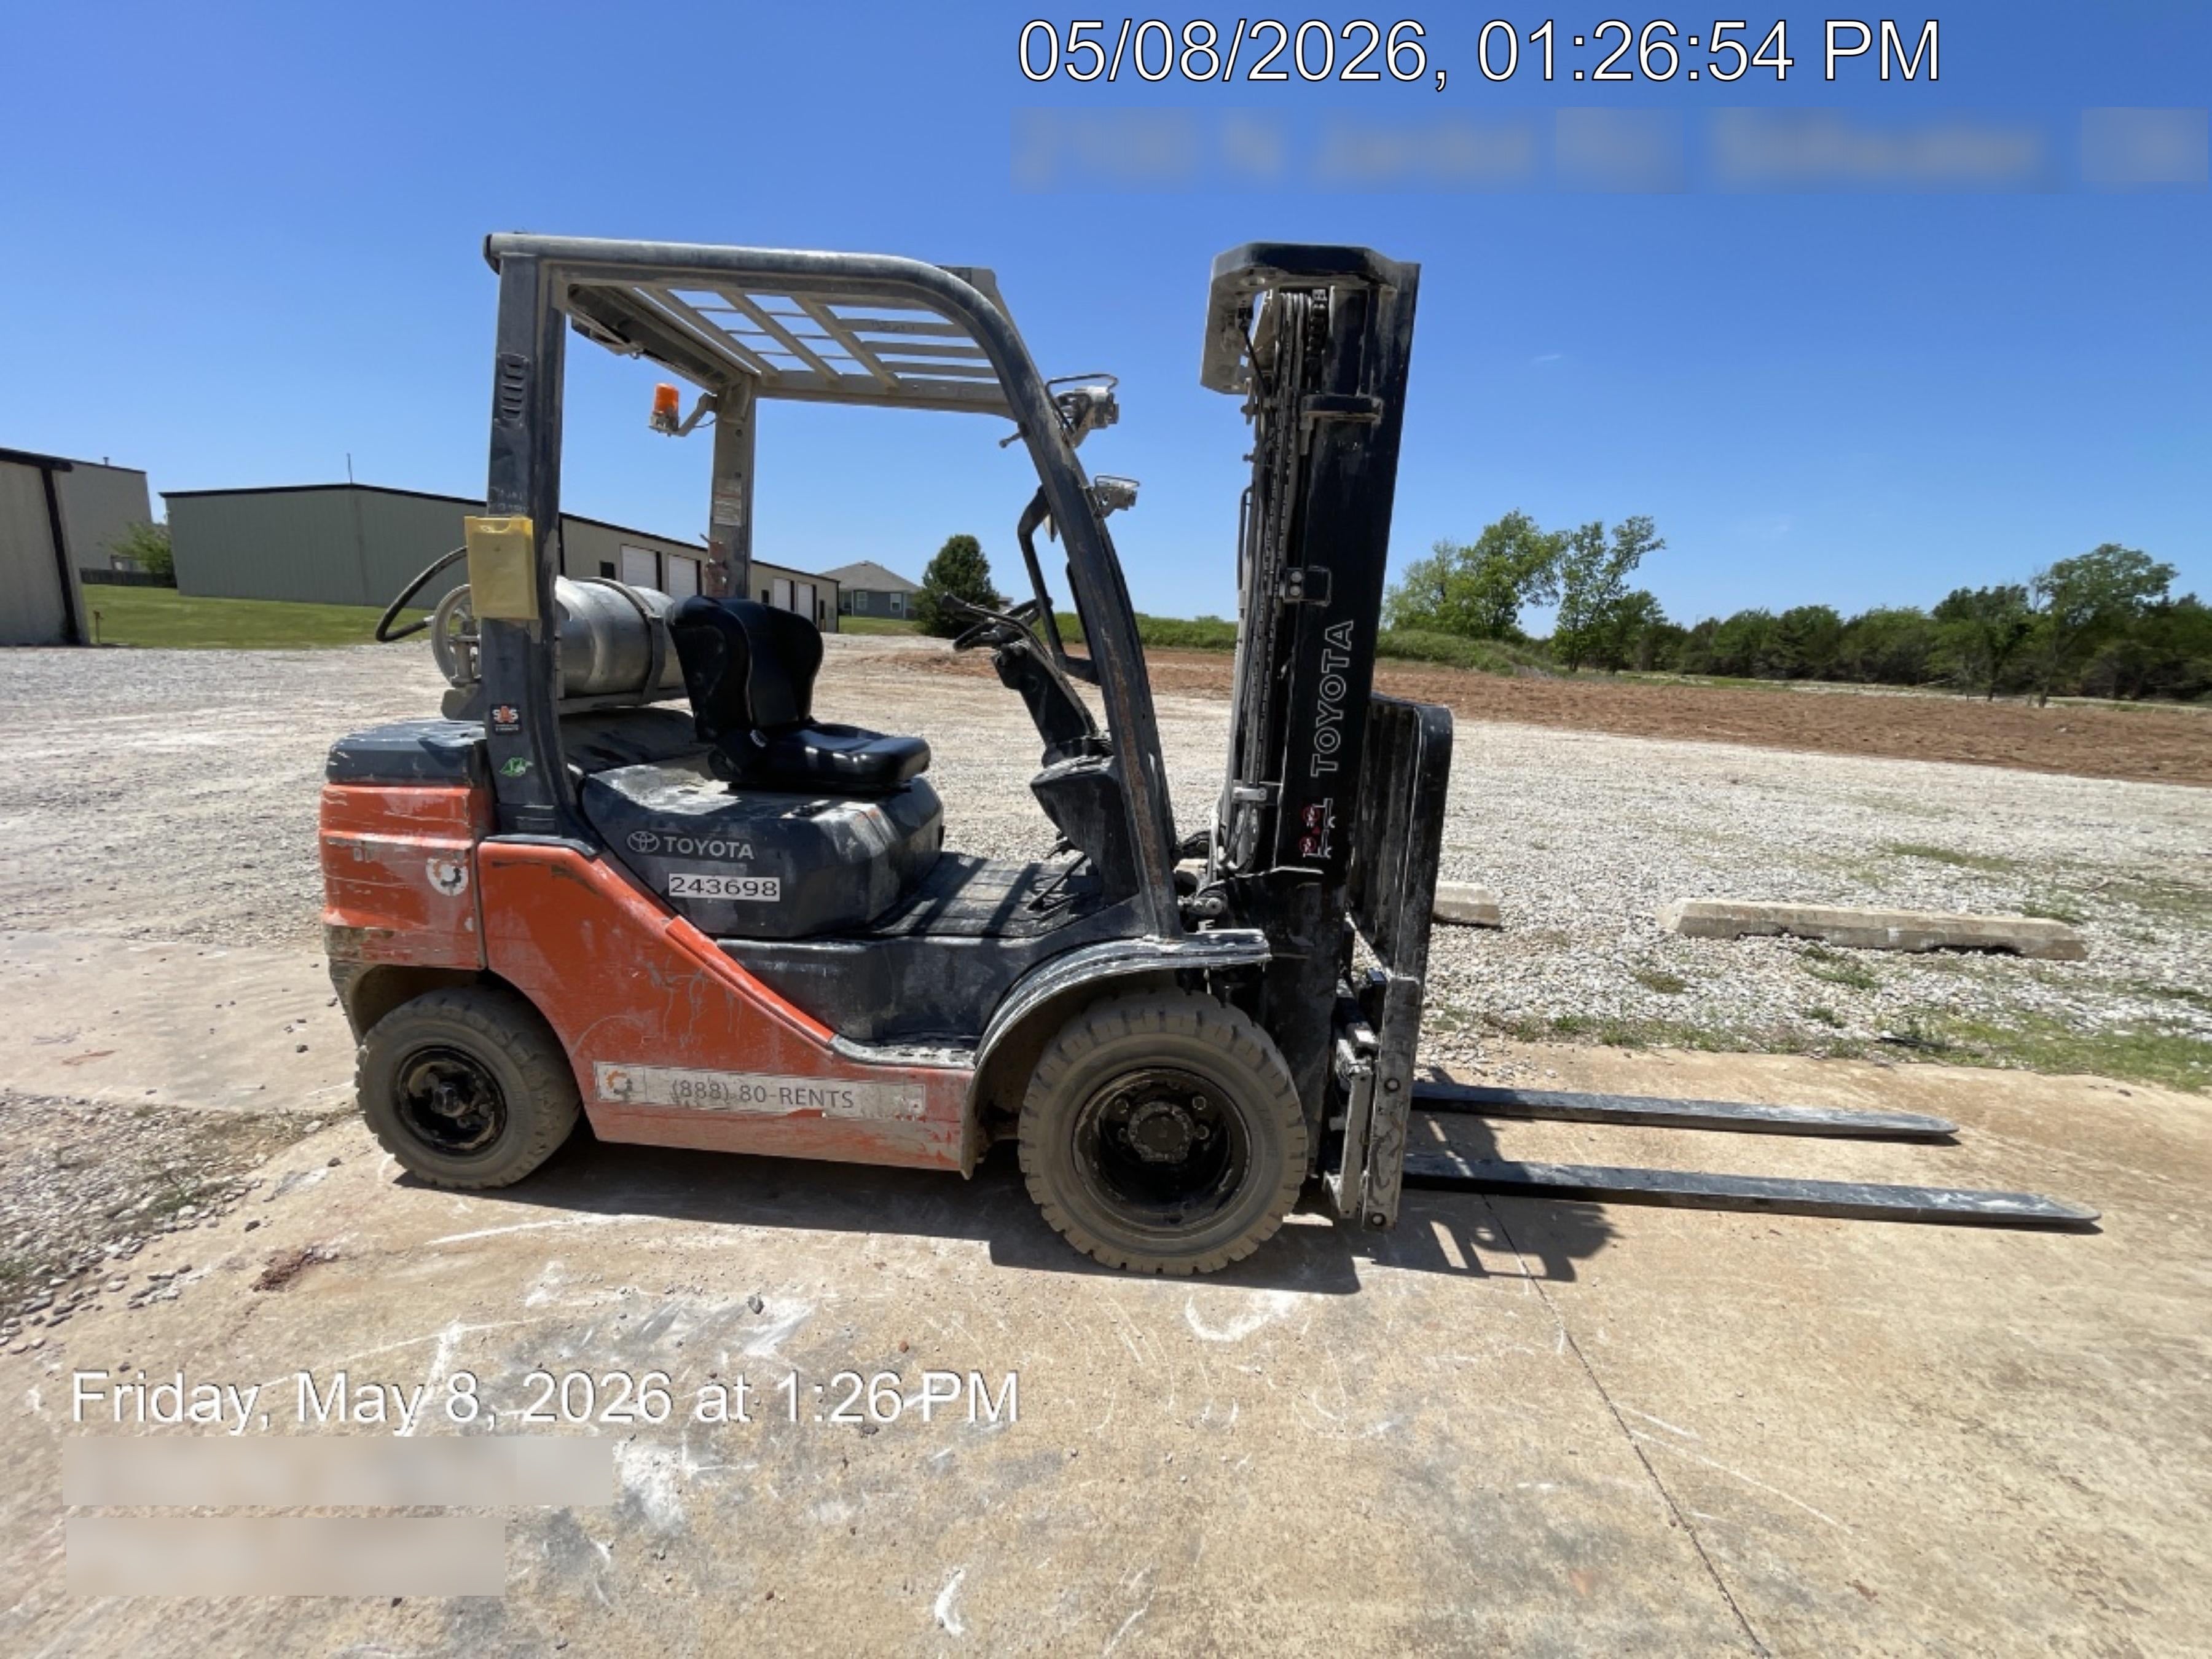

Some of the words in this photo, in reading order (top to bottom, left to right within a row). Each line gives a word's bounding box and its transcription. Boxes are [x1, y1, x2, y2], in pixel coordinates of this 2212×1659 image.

[1311, 621, 1354, 778] TOYOTA
[664, 836, 754, 860] TOYOTA
[670, 877, 777, 896] 243698
[672, 1080, 729, 1104] (888)
[739, 1084, 855, 1108] 80-RENTS
